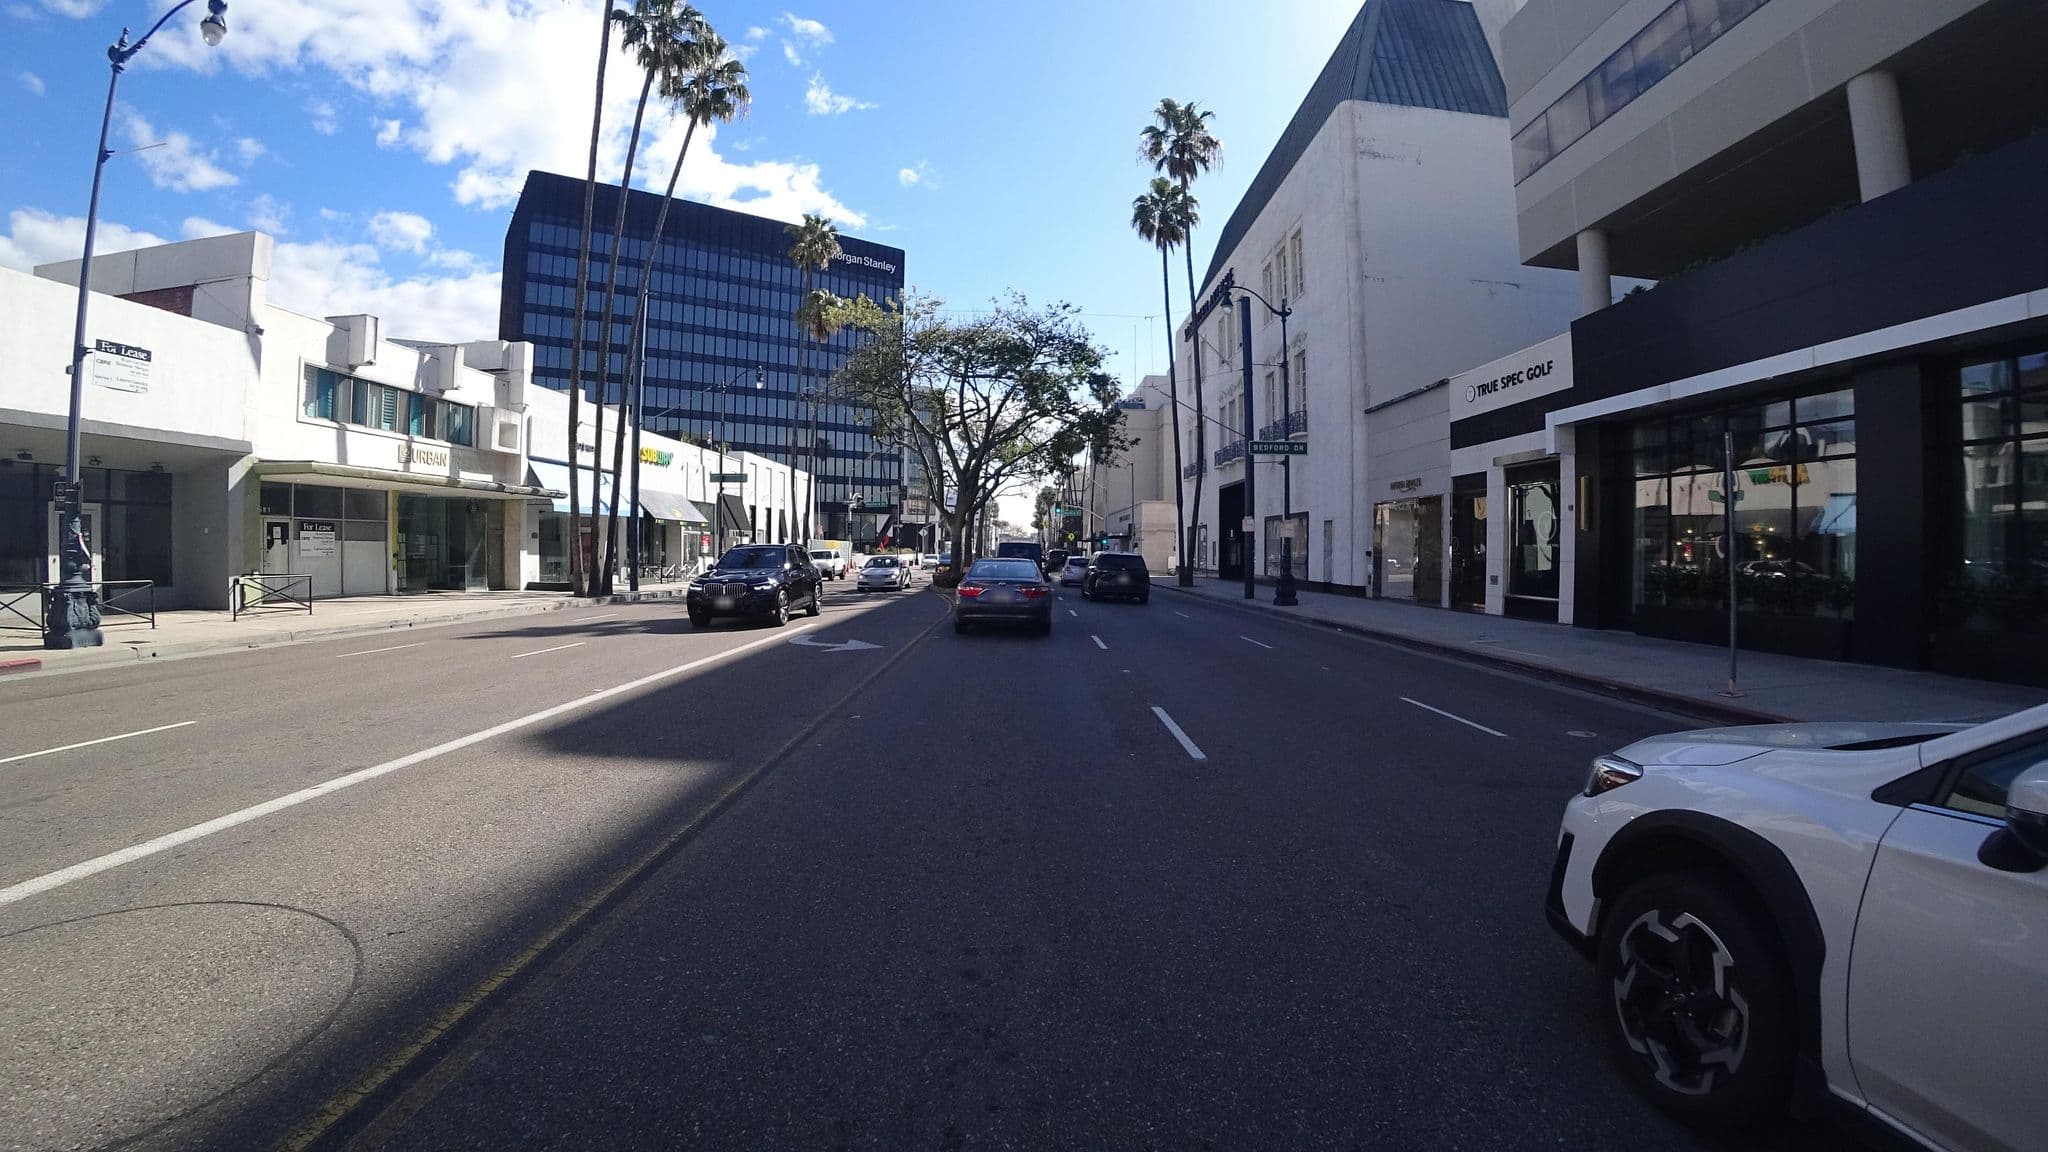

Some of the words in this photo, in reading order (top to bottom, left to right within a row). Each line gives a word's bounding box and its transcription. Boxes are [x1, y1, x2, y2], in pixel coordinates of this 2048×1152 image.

[863, 256, 897, 274] Stanley
[101, 341, 117, 354] For
[120, 345, 148, 360] Lease
[1476, 379, 1499, 397] TRUE
[1501, 370, 1524, 389] SPEC
[1526, 360, 1553, 381] GOLF
[411, 447, 448, 467] URBAN
[1253, 444, 1289, 452] BEDFORD
[1293, 444, 1305, 452] DR
[303, 522, 315, 532] For
[315, 523, 334, 532] Lease
